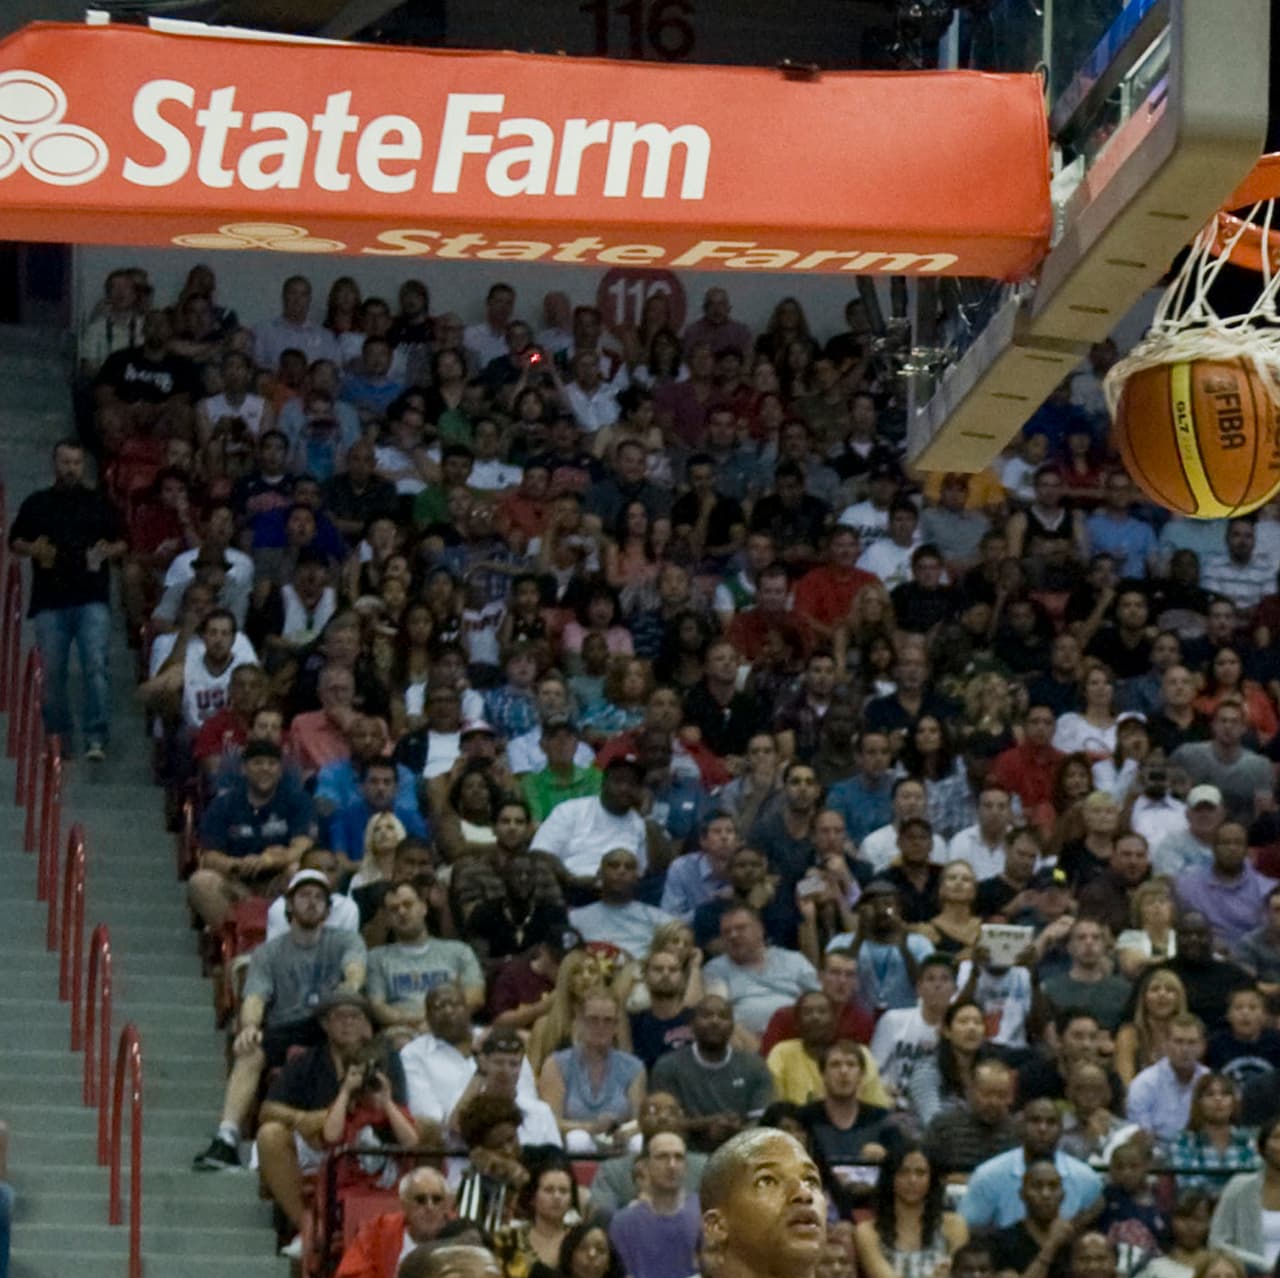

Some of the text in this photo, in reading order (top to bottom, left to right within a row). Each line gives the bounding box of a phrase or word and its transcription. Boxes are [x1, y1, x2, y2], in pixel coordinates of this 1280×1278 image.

[578, 0, 697, 60] 116
[122, 78, 711, 200] State Farm
[361, 228, 959, 273] State Farm
[1215, 392, 1247, 450] FIBA
